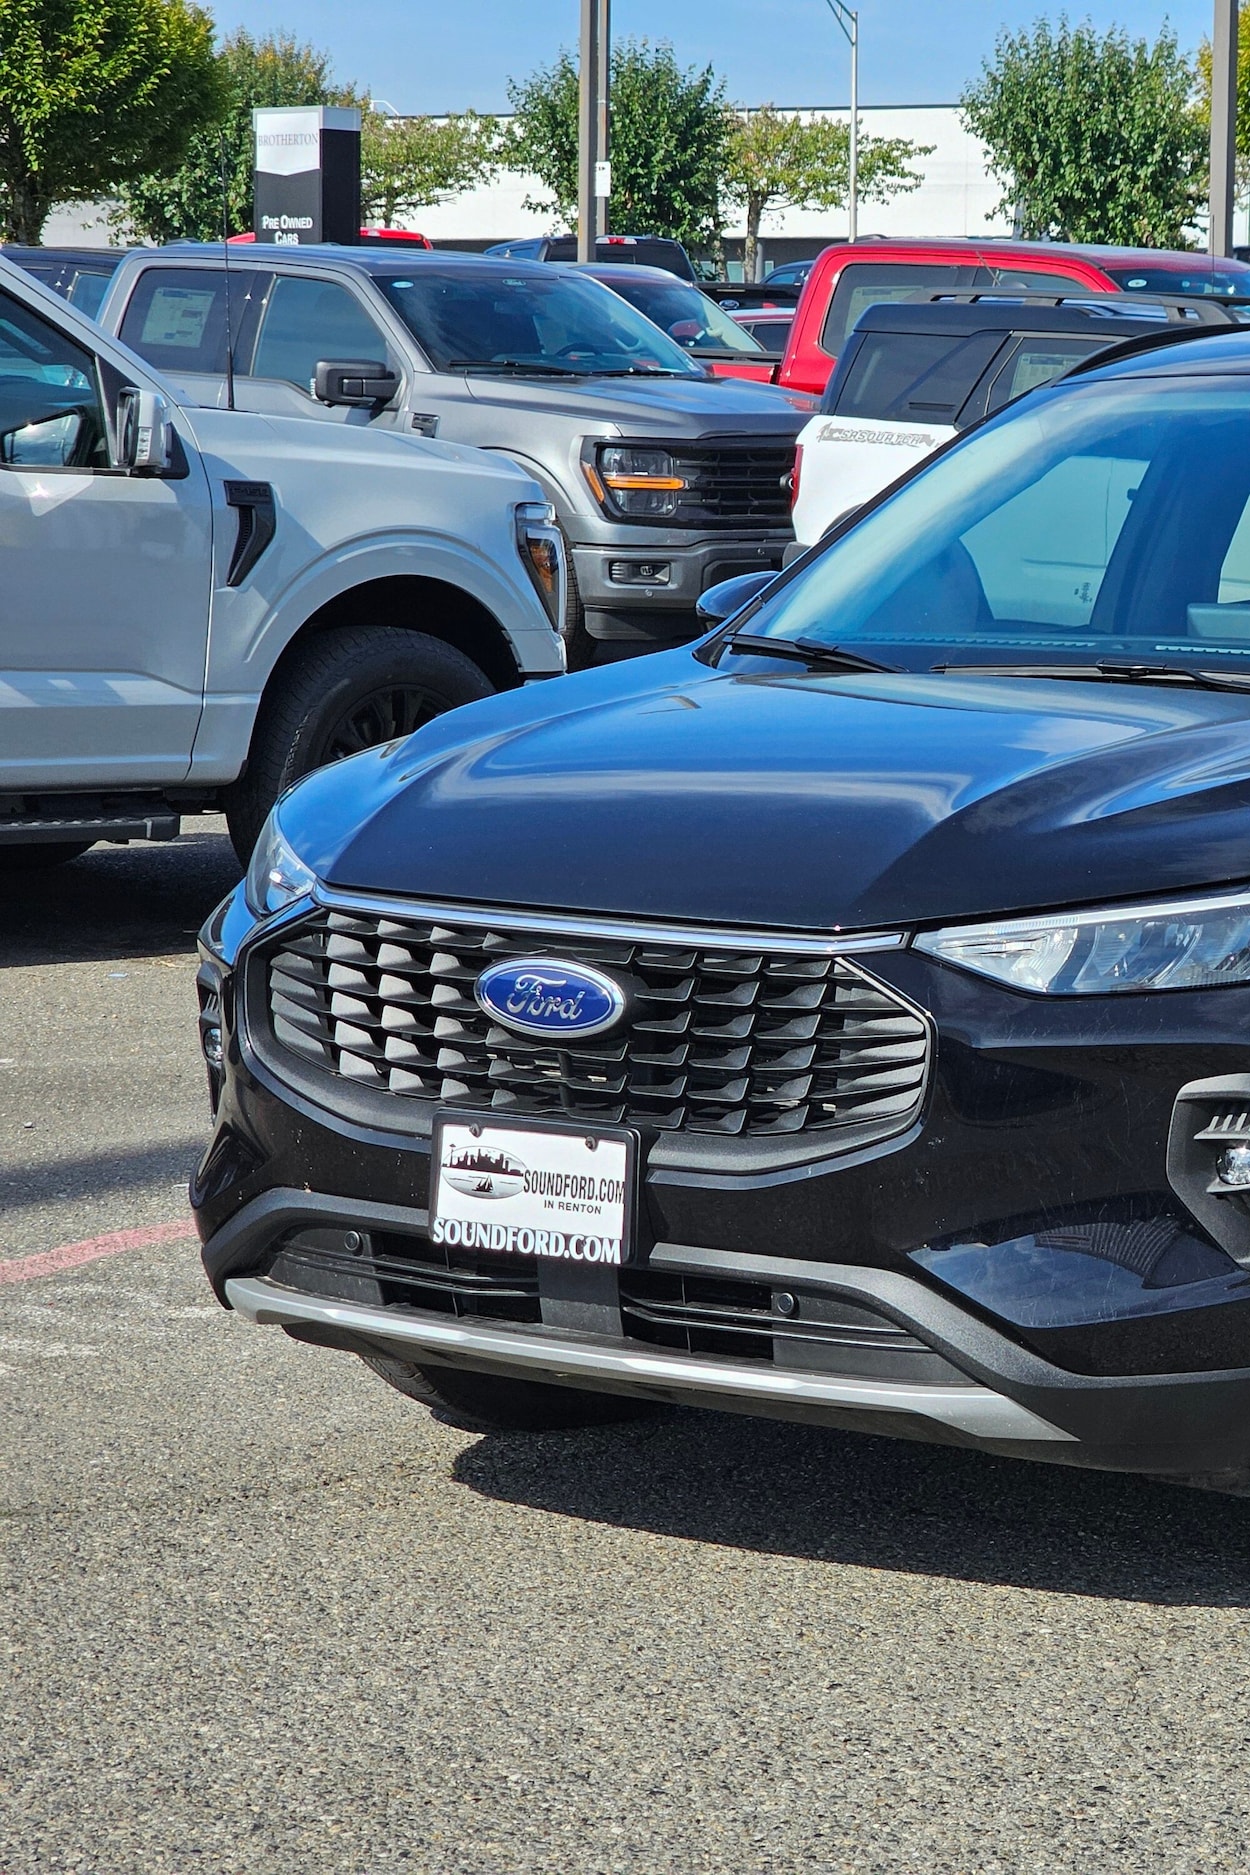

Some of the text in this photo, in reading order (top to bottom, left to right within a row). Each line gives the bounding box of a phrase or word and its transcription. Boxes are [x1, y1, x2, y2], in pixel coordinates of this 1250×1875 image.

[258, 133, 319, 146] BROTHERTON
[840, 429, 922, 446] SASQUATCH
[506, 973, 586, 1021] Ford
[523, 1169, 626, 1205] SOUNDFORD.COM
[544, 1199, 602, 1215] IN RENTON
[432, 1216, 622, 1265] SOUNDFORD.COM
